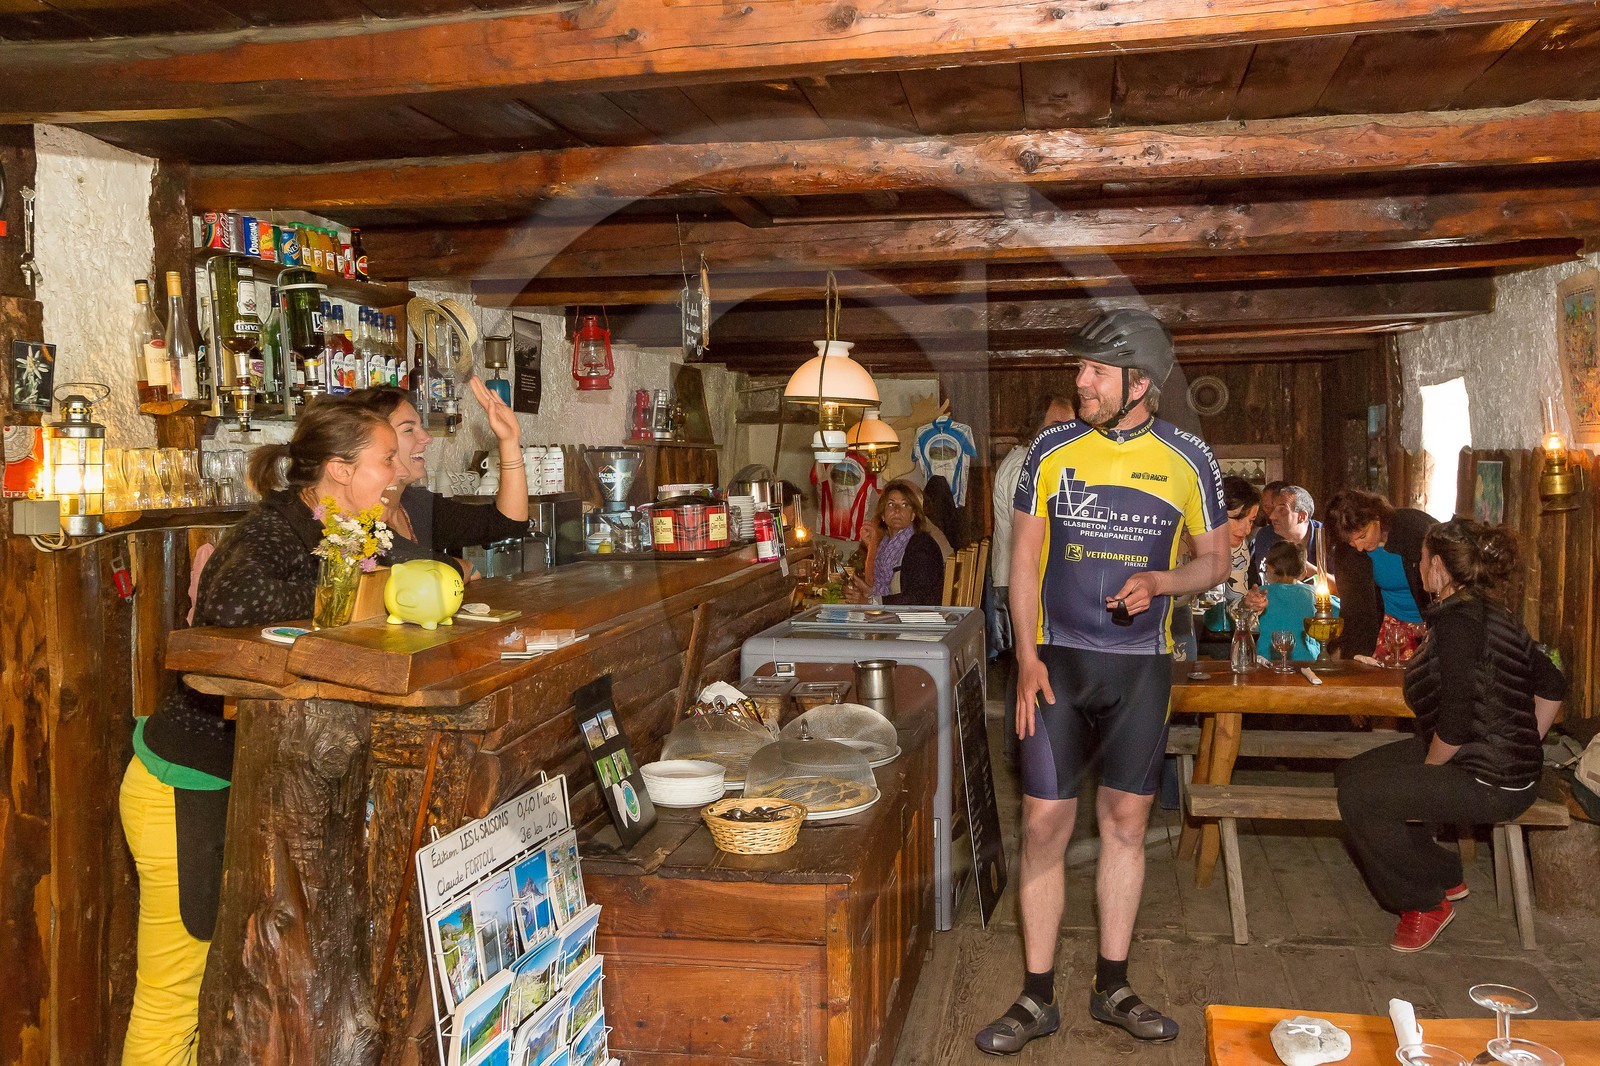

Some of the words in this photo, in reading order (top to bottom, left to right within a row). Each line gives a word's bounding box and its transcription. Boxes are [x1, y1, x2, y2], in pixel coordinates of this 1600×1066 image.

[249, 222, 260, 254] ORANGINA
[1024, 422, 1077, 466] VETROARREDO
[1150, 474, 1168, 482] RACER
[1174, 428, 1226, 510] VERHAERT.BE
[1062, 520, 1106, 531] GLASBETON
[1112, 525, 1162, 536] GLASTEGELS
[1080, 530, 1144, 542] PREFABPANELEN
[1160, 518, 1172, 527] nv
[1086, 550, 1148, 563] VETROARREDO
[517, 796, 536, 821] 0,40
[430, 848, 459, 868] Édition
[460, 830, 474, 852] LES
[474, 828, 480, 843] 4
[480, 810, 509, 840] SAISONS
[520, 826, 532, 844] 3€
[546, 812, 558, 828] 10
[437, 870, 464, 896] Claude
[464, 846, 496, 879] FORTOUL
